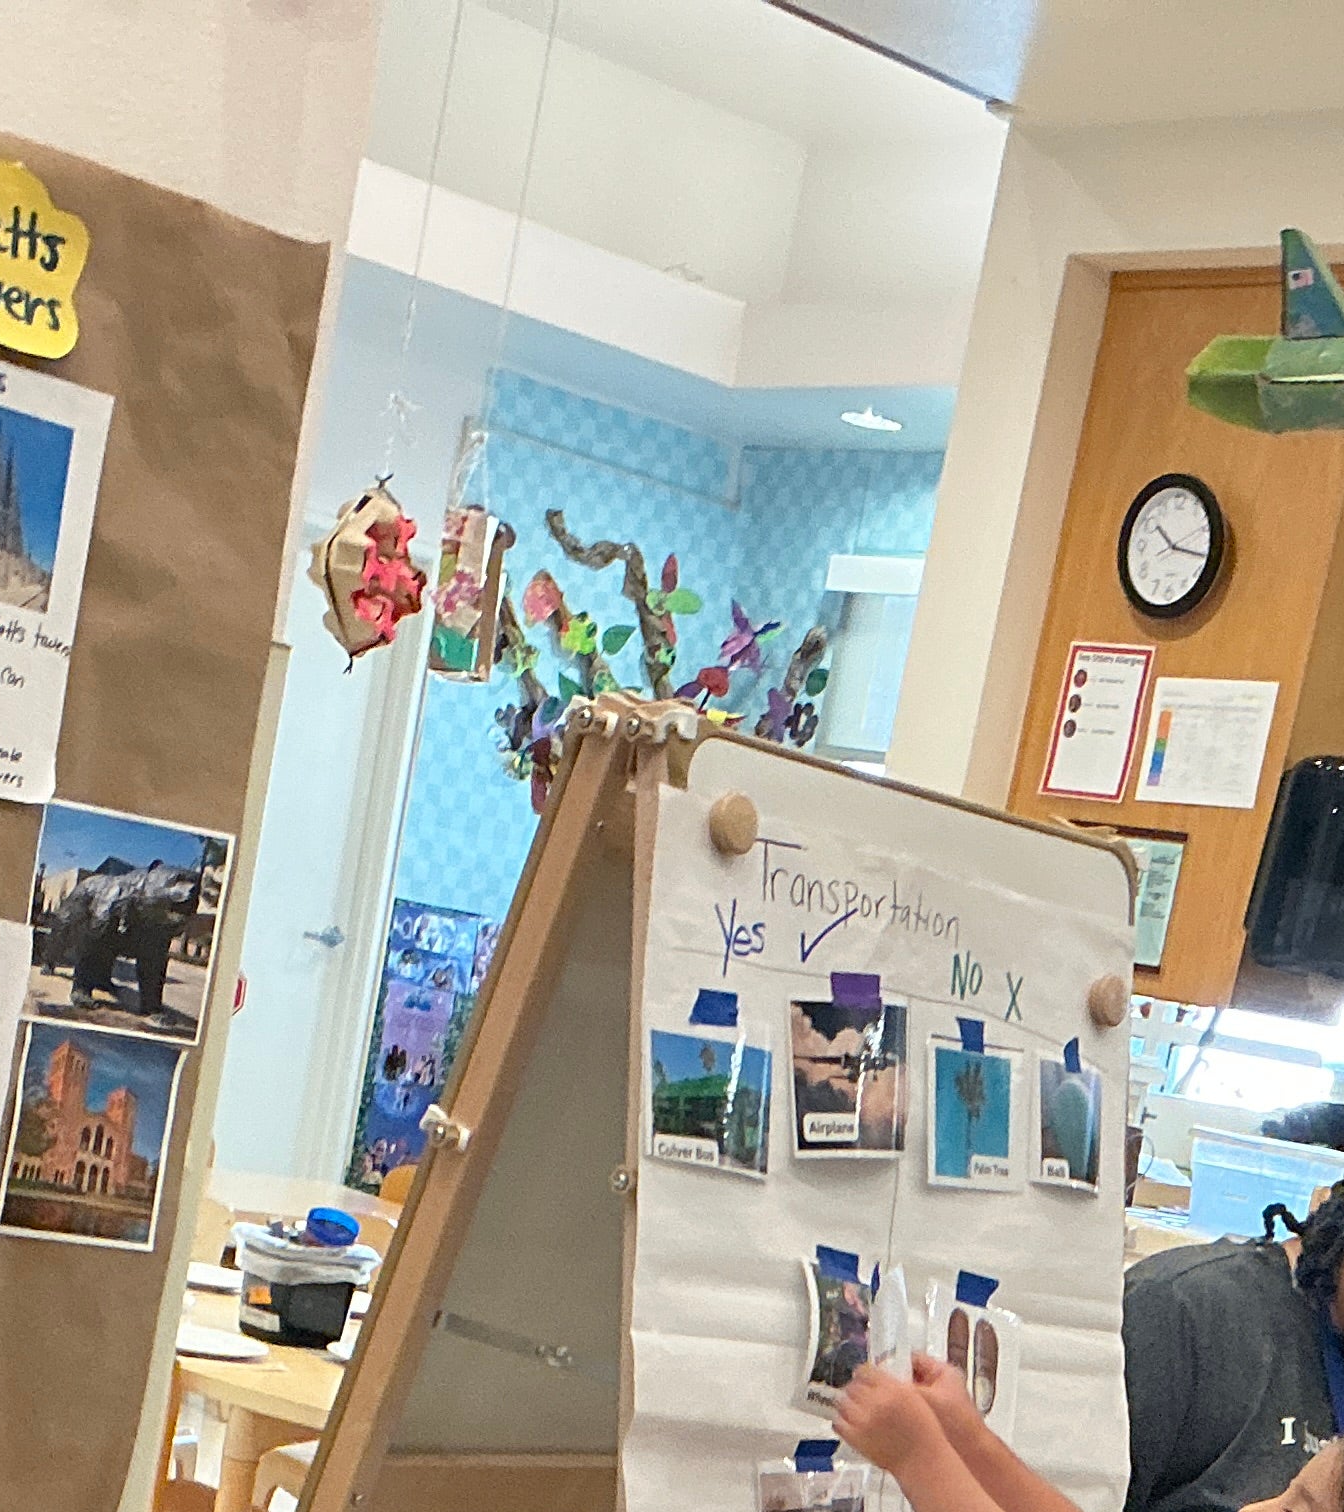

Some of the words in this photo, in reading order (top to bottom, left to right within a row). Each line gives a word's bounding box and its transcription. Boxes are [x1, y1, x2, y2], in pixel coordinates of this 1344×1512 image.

[756, 837, 961, 946] Transportation
[714, 897, 767, 979] Yes
[808, 1120, 856, 1138] Airplane
